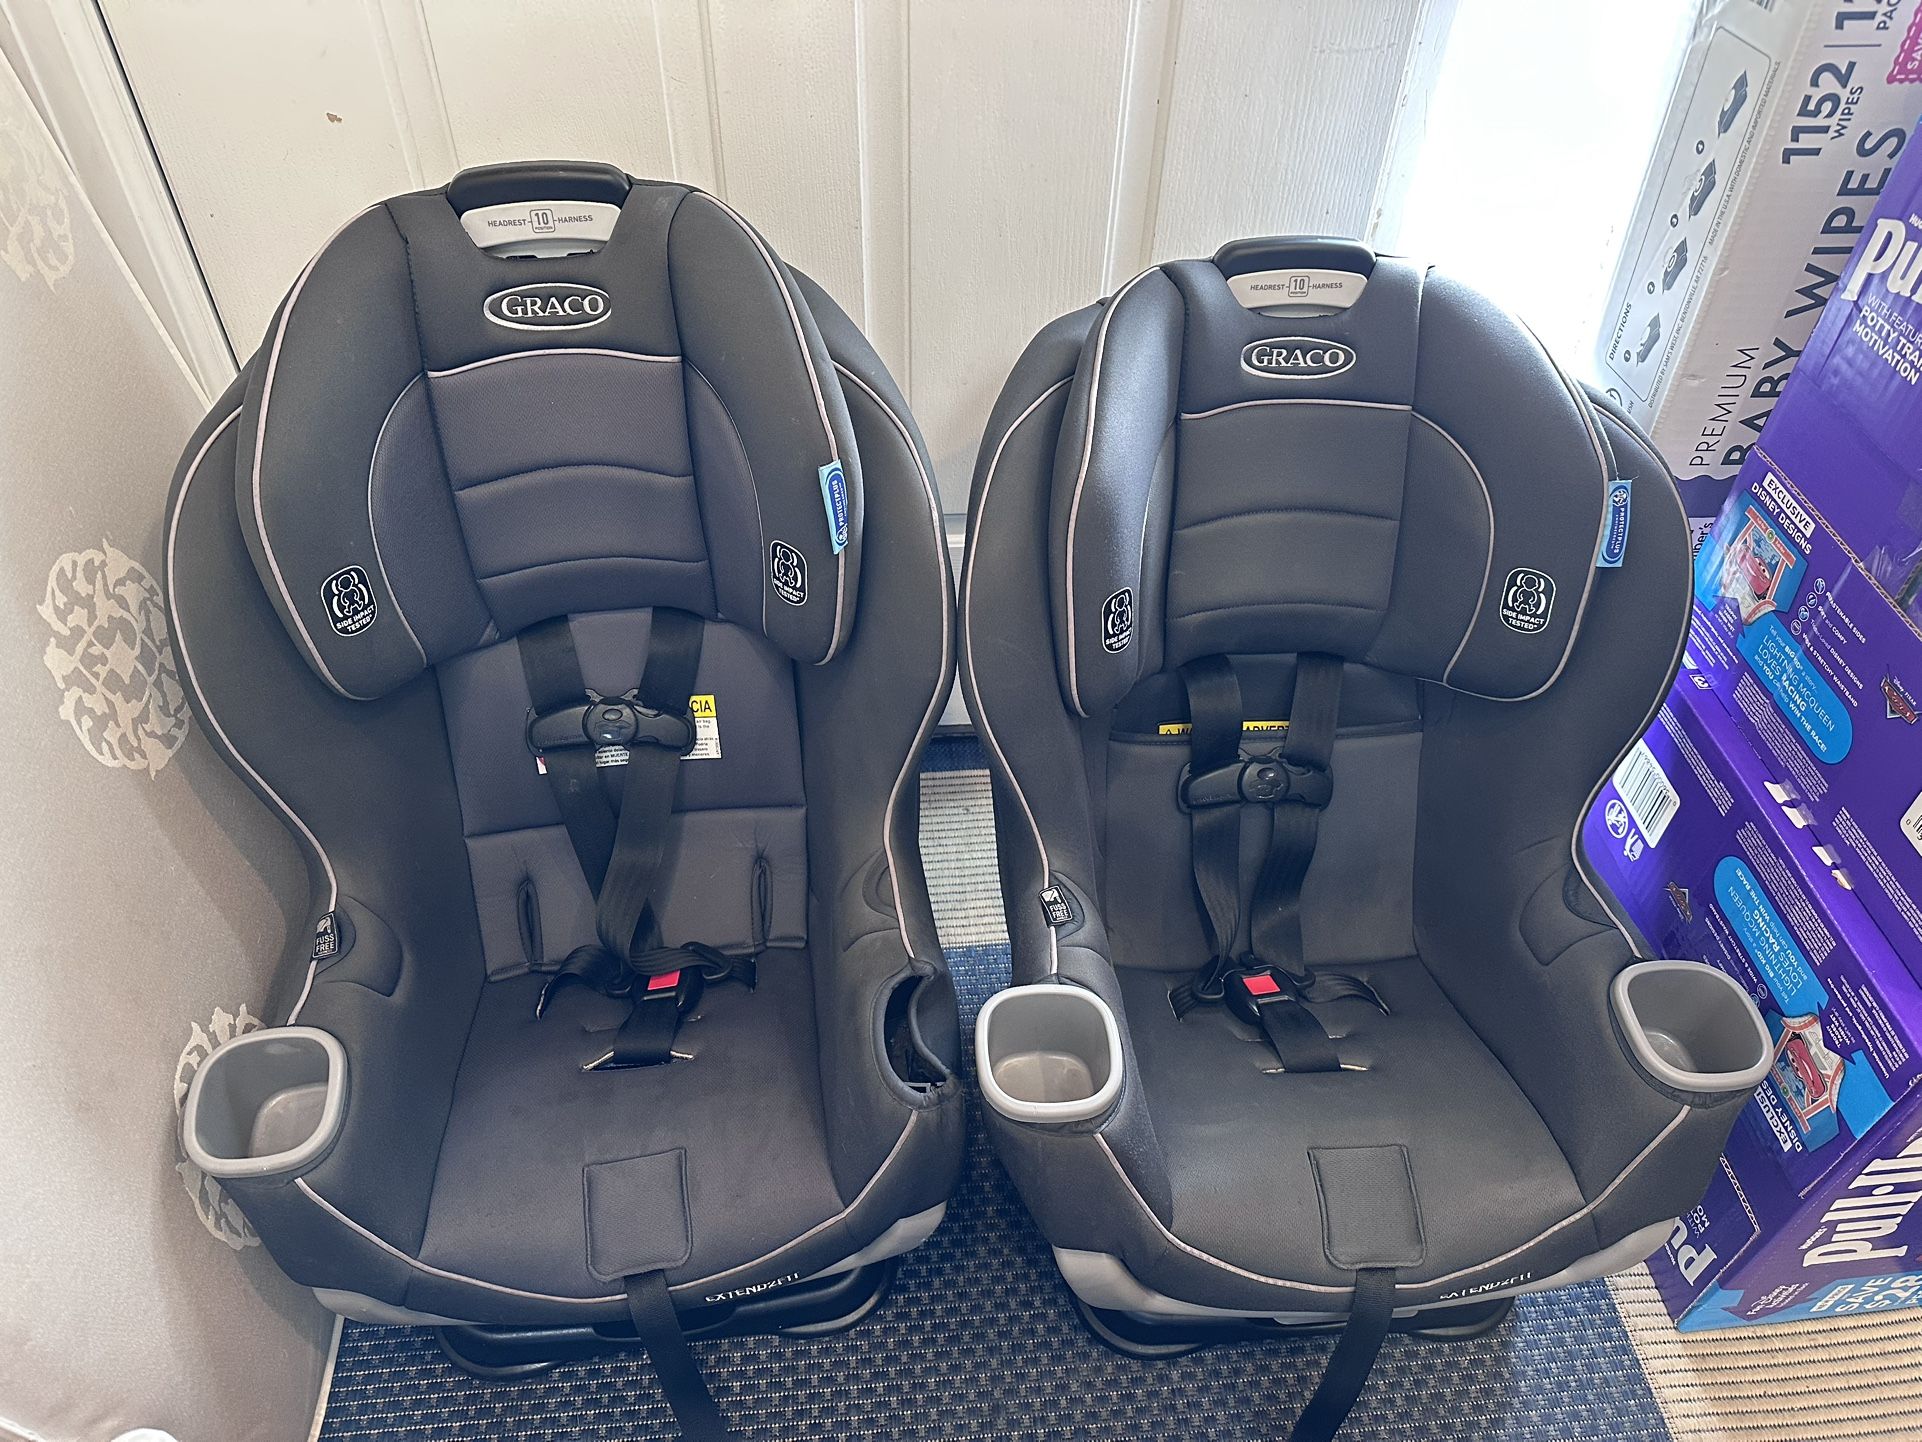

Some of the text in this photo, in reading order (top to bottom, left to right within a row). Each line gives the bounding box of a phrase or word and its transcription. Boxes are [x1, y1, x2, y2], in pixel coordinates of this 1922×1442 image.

[1781, 60, 1857, 165] 1152
[1830, 85, 1864, 140] WIPES
[488, 212, 593, 228] HEADREST 10 HARNESS
[1784, 127, 1907, 319] WIPES
[1840, 218, 1922, 304] Pu
[1293, 278, 1305, 291] 10
[1312, 282, 1343, 290] HARNESS
[501, 295, 604, 318] GRACO
[1860, 304, 1898, 345] POTTY
[1868, 293, 1892, 319] WITH
[1608, 301, 1632, 362] DIRECTIONS
[1853, 319, 1920, 386] MOTIVATION
[1251, 346, 1345, 367] GRACO
[1689, 346, 1760, 466] PREMIUM
[1751, 483, 1781, 521] DISNEY
[1778, 516, 1812, 555] DESIGNS
[1766, 478, 1812, 533] EXCLUSIVE
[1613, 507, 1625, 554] PROTECTPLUS
[336, 604, 375, 630] SIDE IMPACT
[1502, 608, 1545, 625] SIDE IMPACT
[1830, 624, 1848, 645] COMFY
[1782, 643, 1796, 659] BIG
[1828, 646, 1846, 667] DISNEY
[1842, 664, 1864, 690] DESIGNS
[1752, 653, 1764, 666] and
[1760, 663, 1775, 679] YOU
[1786, 700, 1802, 718] WIN
[1797, 715, 1814, 733] THE
[1755, 643, 1783, 676] LOVES
[1778, 671, 1808, 712] RACING
[1761, 634, 1801, 685] LIGHTNING
[1795, 681, 1837, 732] MCQUEEN
[1811, 649, 1834, 676] STRETCHY
[1830, 673, 1859, 708] WAISTBAND
[1049, 903, 1067, 912] FUSS
[1052, 909, 1069, 919] FREE
[1726, 885, 1762, 937] MCQUEEN
[1733, 866, 1808, 981] and YOU can help WIN THE RACE!
[315, 941, 335, 953] FREE
[316, 933, 335, 945] FUSS
[1750, 908, 1781, 952] RACING
[1756, 935, 1798, 996] LIGHTNING
[1763, 962, 1775, 978] BIG
[1776, 950, 1804, 989] LOVES
[1780, 990, 1791, 1005] Tell
[1825, 1024, 1841, 1048] TROPHY
[1828, 1012, 1840, 1027] WET
[1829, 1022, 1843, 1042] FADES
[1754, 1089, 1789, 1145] EXCLUSI
[1774, 1104, 1804, 1153] DISNEY
[1835, 1277, 1893, 1312] SAVE
